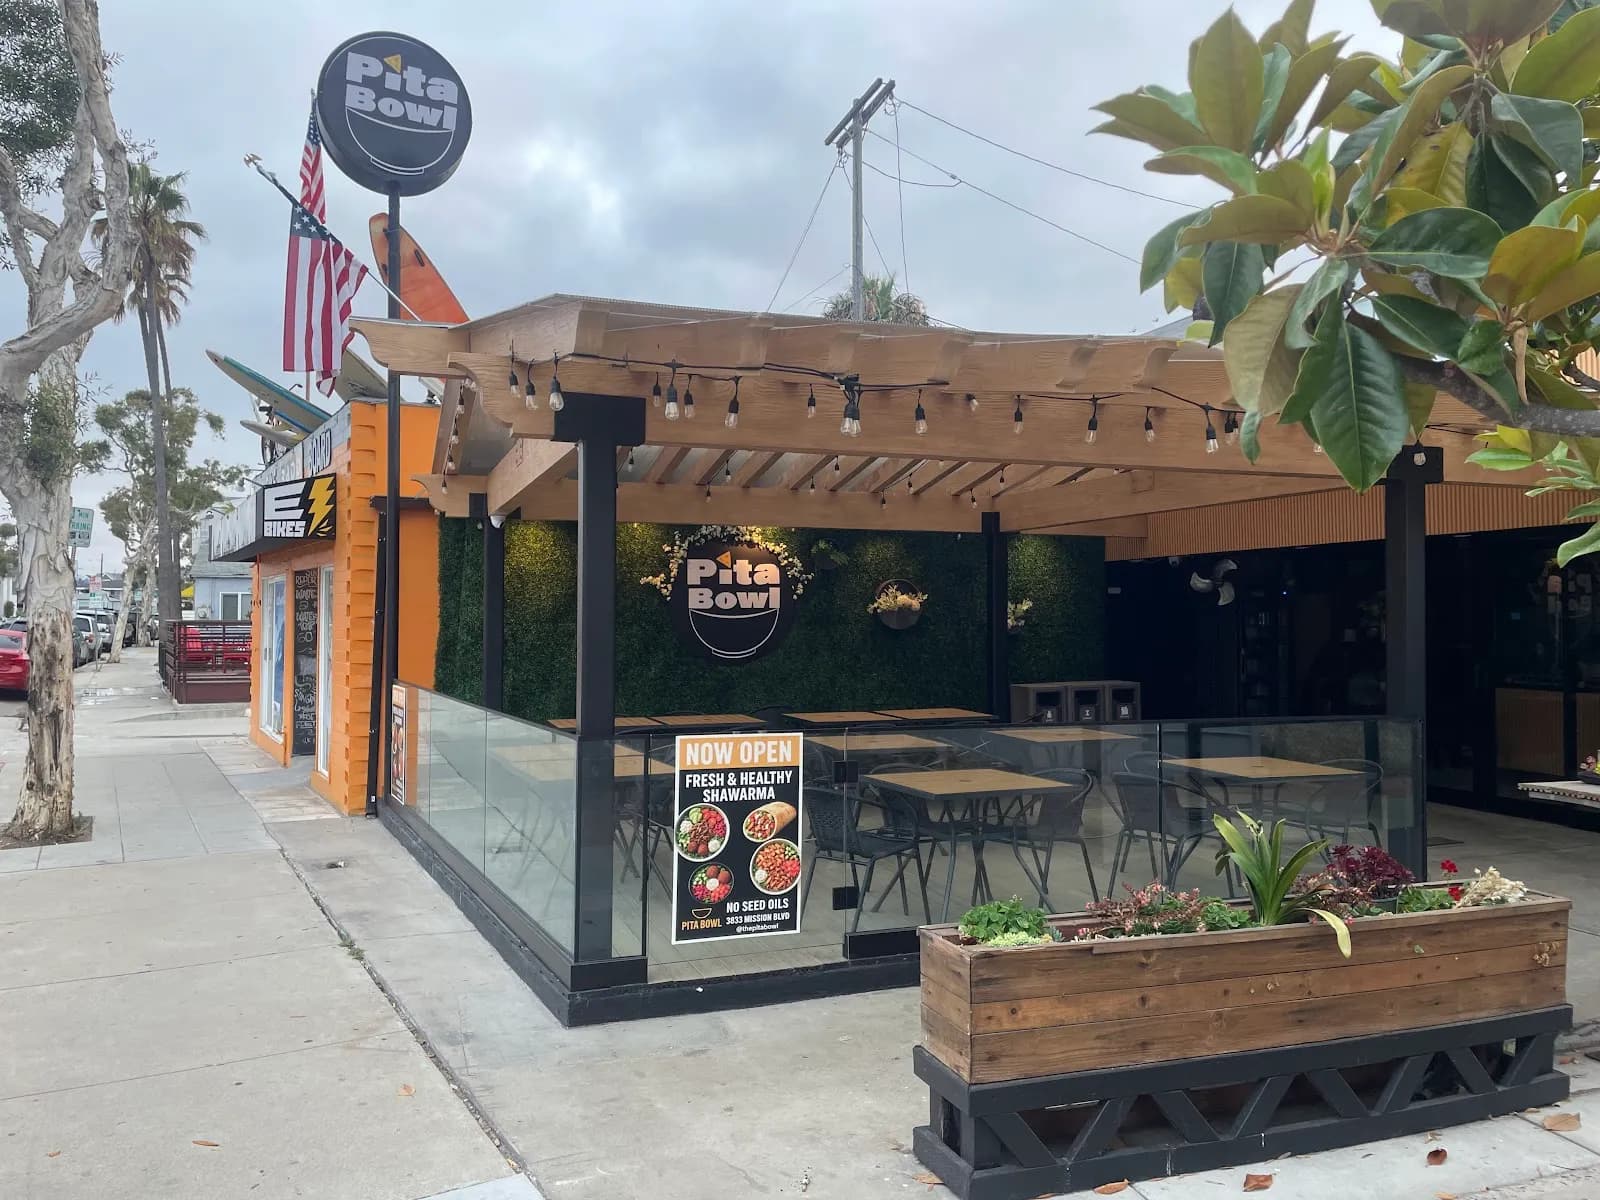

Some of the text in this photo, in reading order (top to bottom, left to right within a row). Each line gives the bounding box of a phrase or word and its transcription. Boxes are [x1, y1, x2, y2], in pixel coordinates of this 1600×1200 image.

[346, 52, 458, 104] Pita
[345, 84, 458, 131] Bowl
[264, 481, 306, 520] E
[264, 521, 306, 537] BIKES
[687, 551, 780, 585] Pita
[688, 587, 781, 610] Bowl
[686, 740, 792, 766] NOW OPEN
[685, 770, 793, 788] FRESH & HEALTHY
[702, 787, 775, 803] SHAWARMA
[726, 897, 789, 914] NO SEED OILS
[681, 917, 722, 931] PITA BOWL
[744, 913, 772, 924] MISSION
[773, 911, 790, 922] BLVD
[736, 922, 779, 934] @thepitabowl
